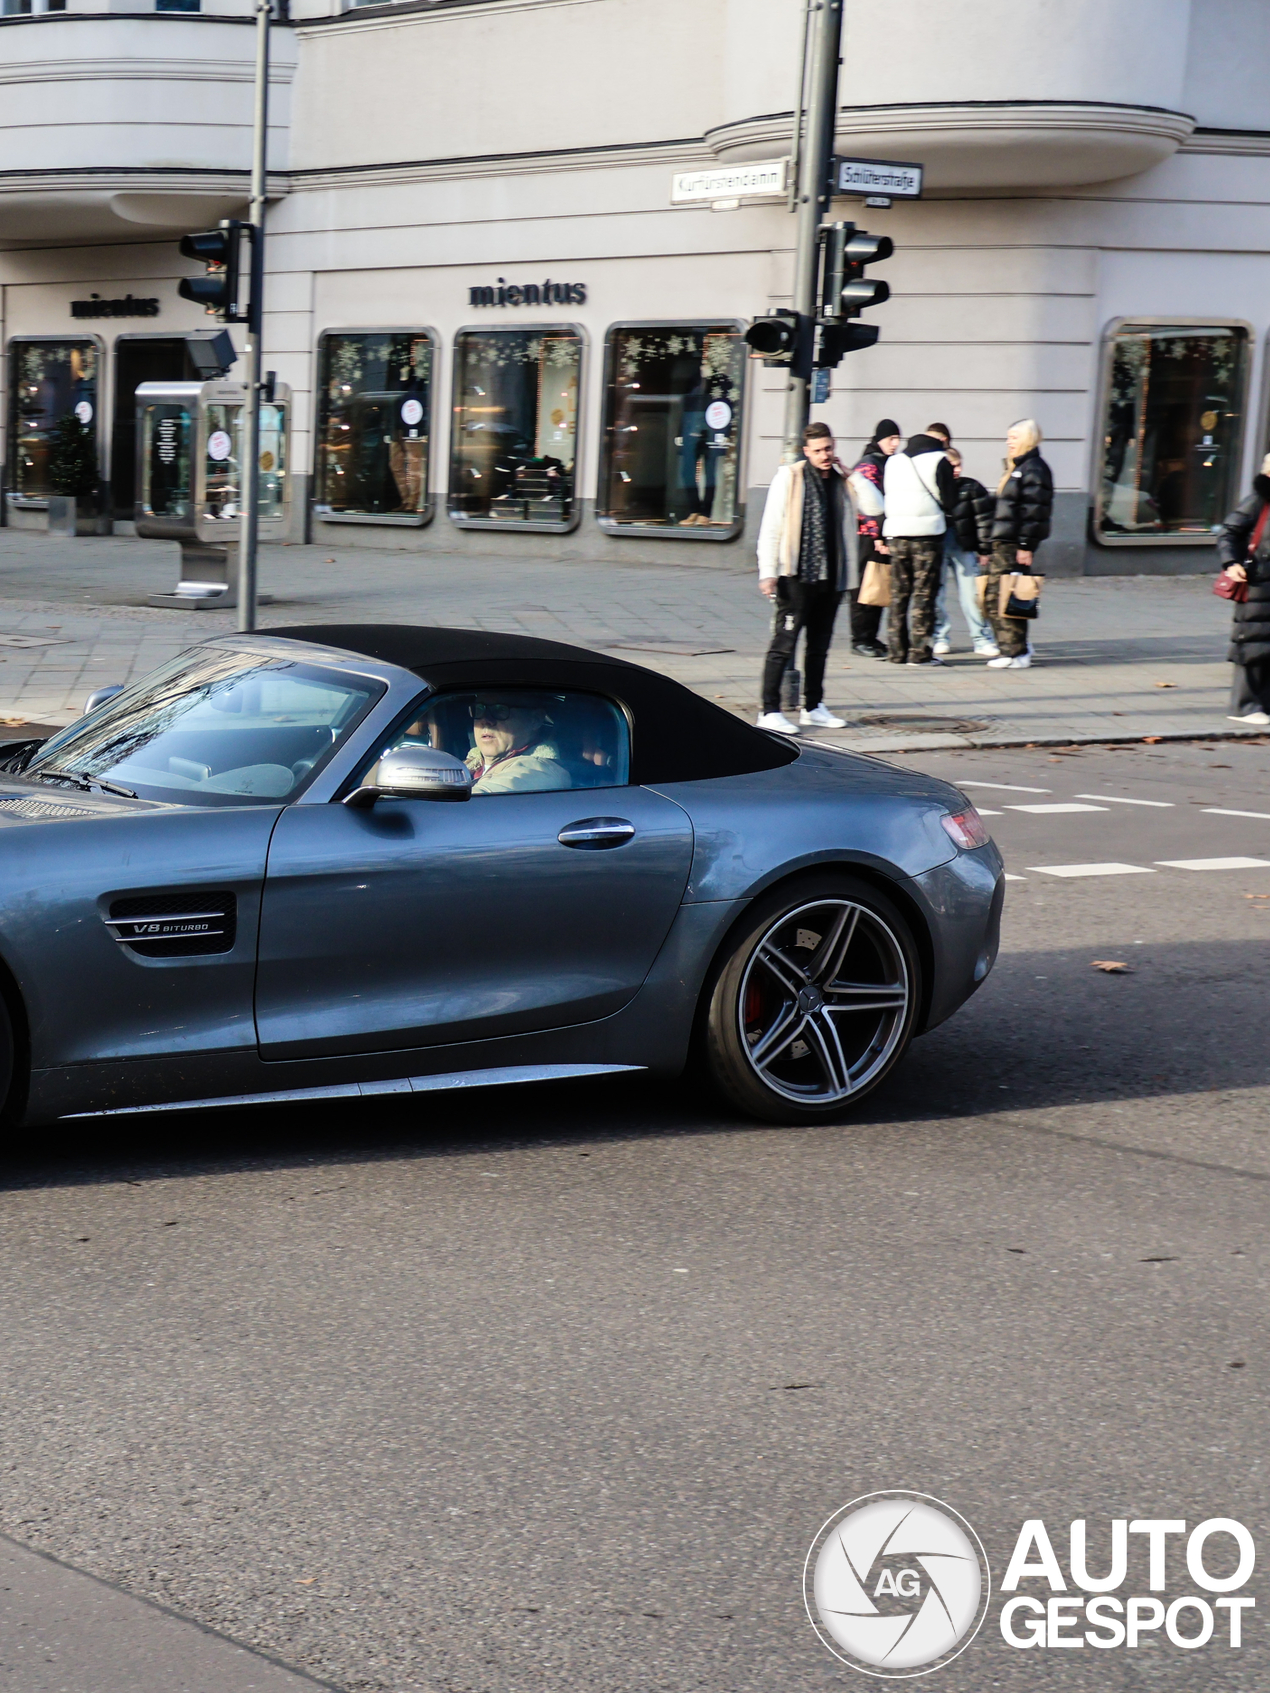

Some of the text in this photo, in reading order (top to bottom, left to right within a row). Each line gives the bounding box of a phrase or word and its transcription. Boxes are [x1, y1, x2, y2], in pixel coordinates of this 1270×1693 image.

[677, 170, 779, 192] Kurfürstendamm
[844, 165, 914, 191] Schlüterstraße
[467, 277, 587, 307] mientus
[133, 923, 209, 933] V8 BITURBO
